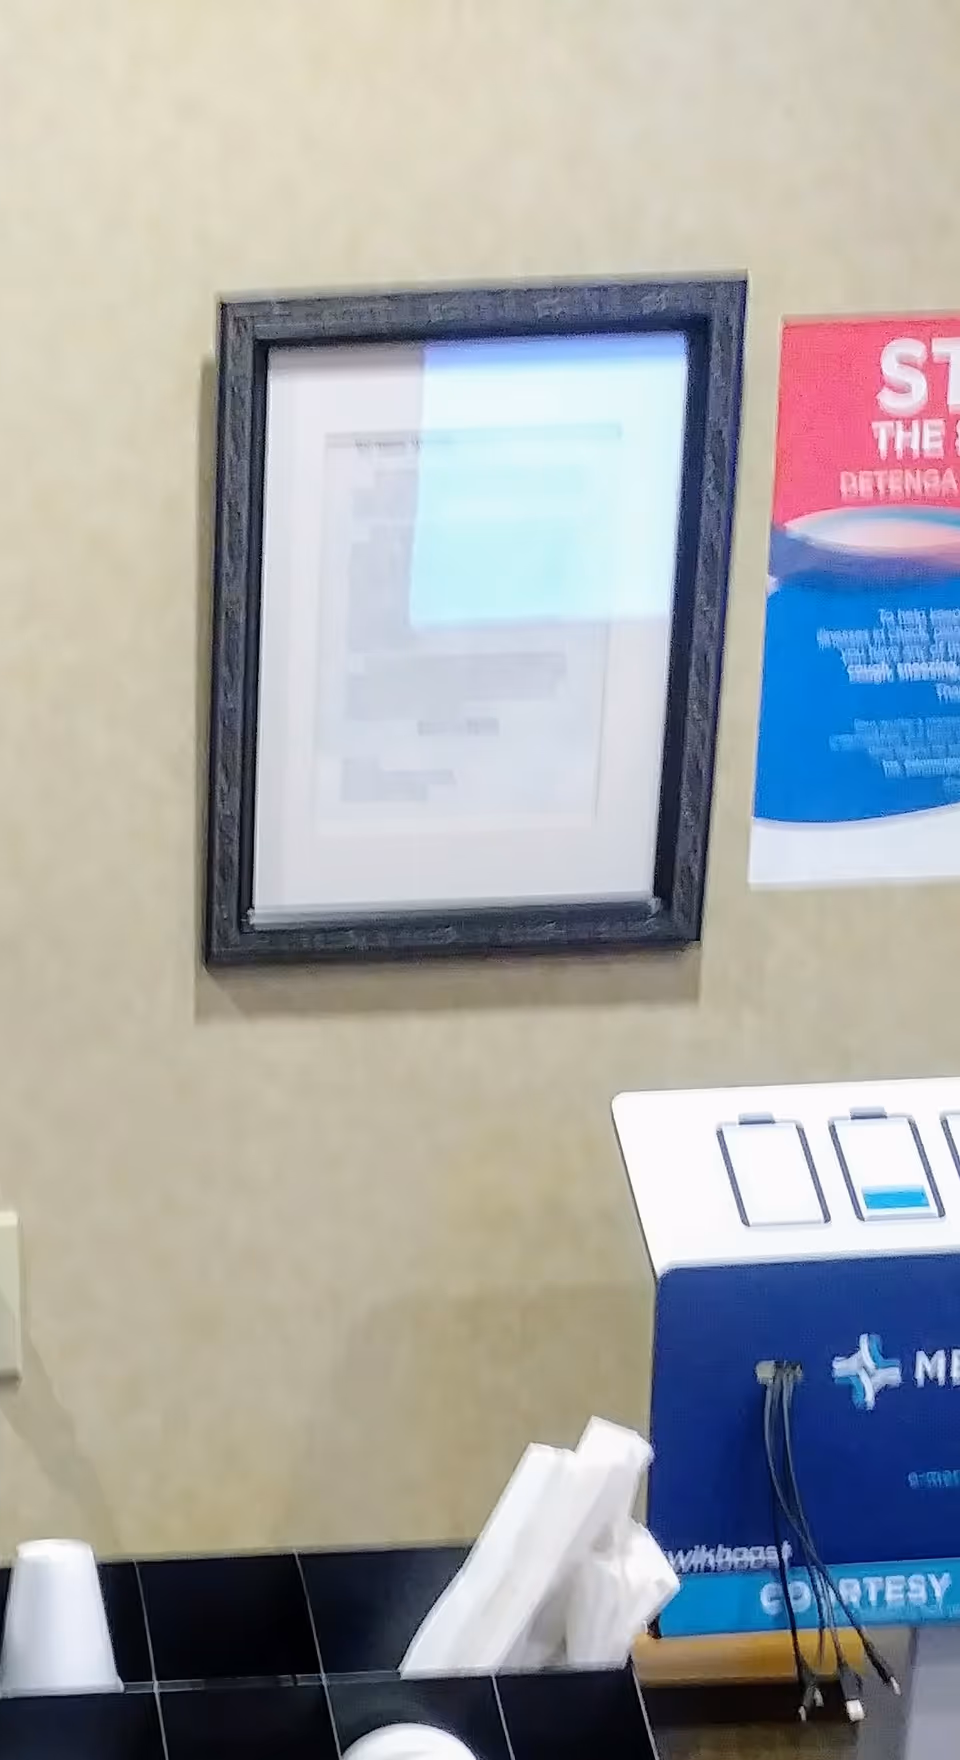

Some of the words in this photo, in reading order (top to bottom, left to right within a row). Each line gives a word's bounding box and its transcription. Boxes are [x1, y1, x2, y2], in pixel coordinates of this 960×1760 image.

[871, 419, 946, 460] THE
[840, 468, 958, 500] DETENGA
[662, 1541, 792, 1576] wikboost
